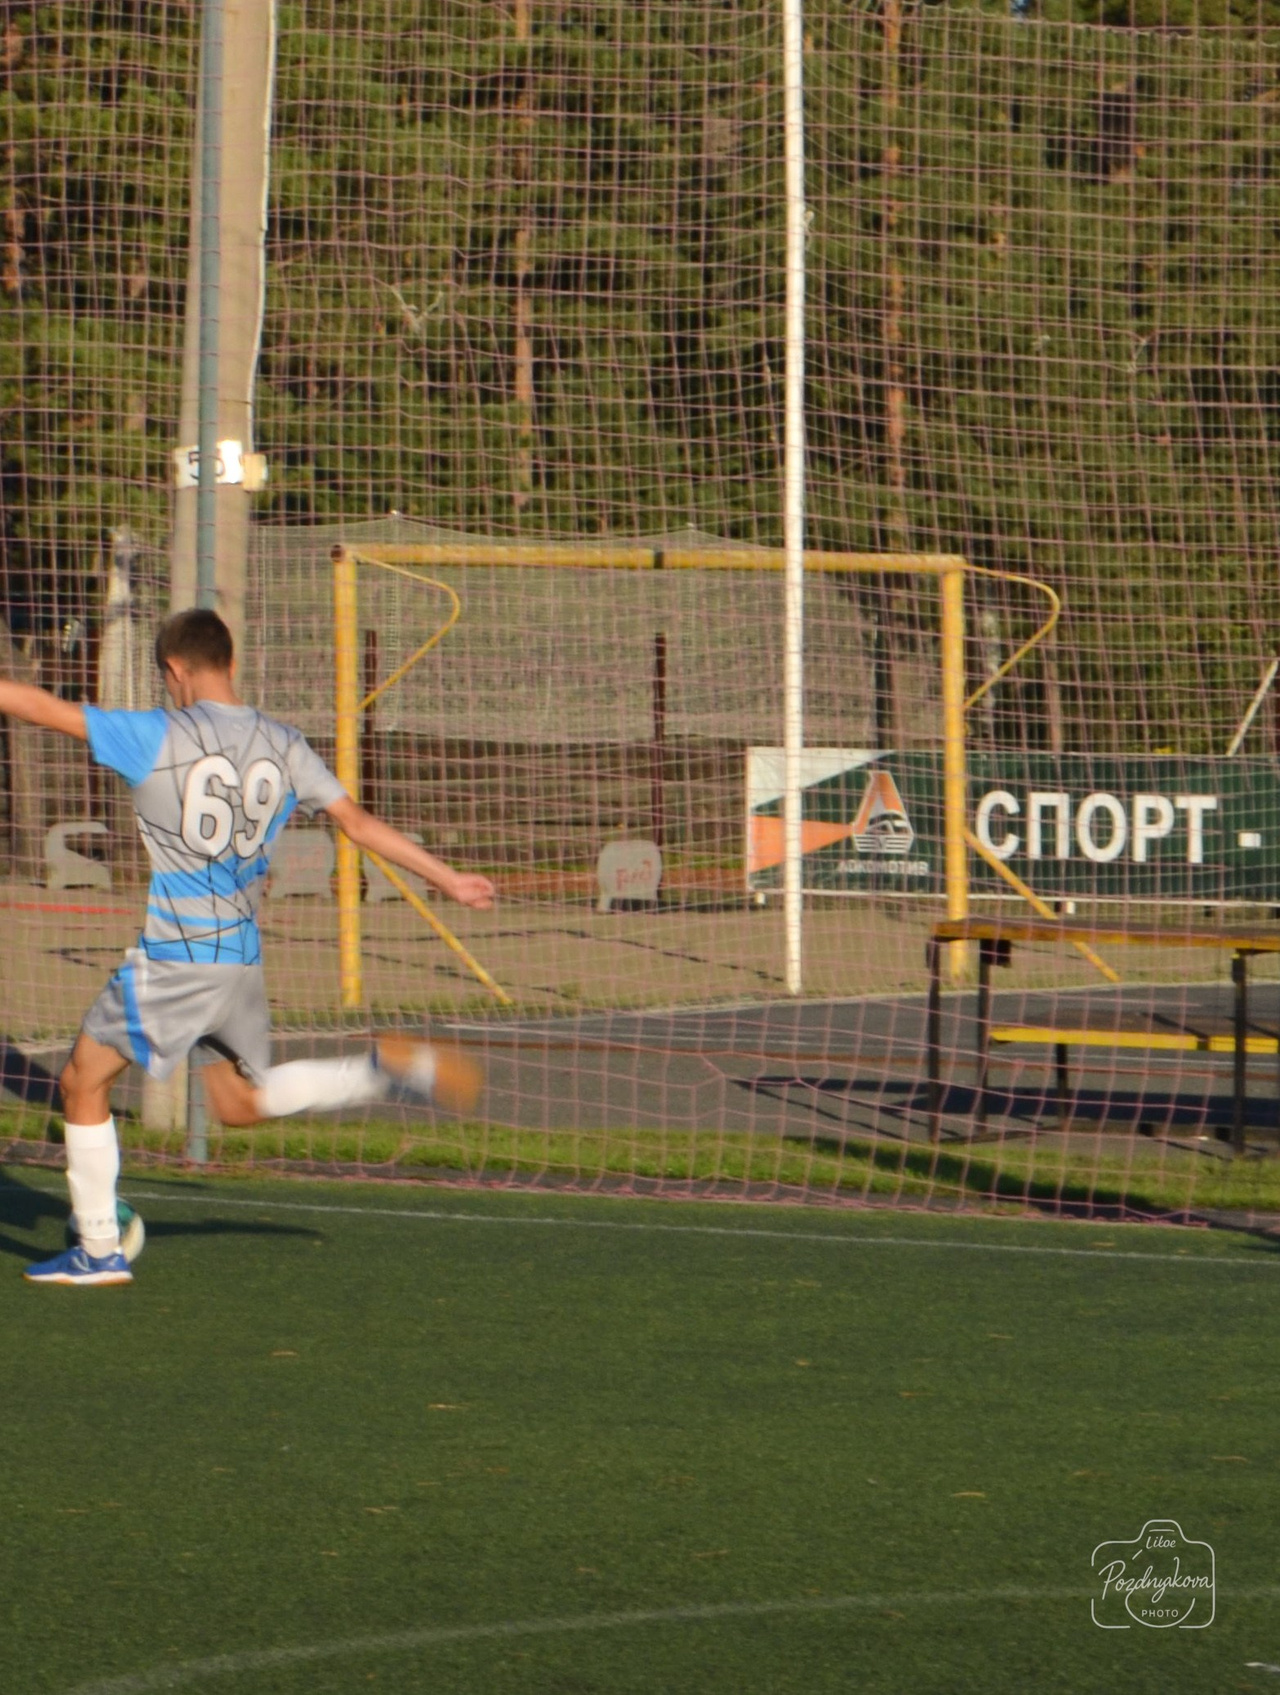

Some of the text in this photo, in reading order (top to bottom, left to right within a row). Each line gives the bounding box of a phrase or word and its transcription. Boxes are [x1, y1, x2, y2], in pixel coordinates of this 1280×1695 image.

[181, 754, 283, 859] 69
[976, 790, 1218, 864] СПОРТ
[837, 858, 929, 876] ЛОКОМОТИВ
